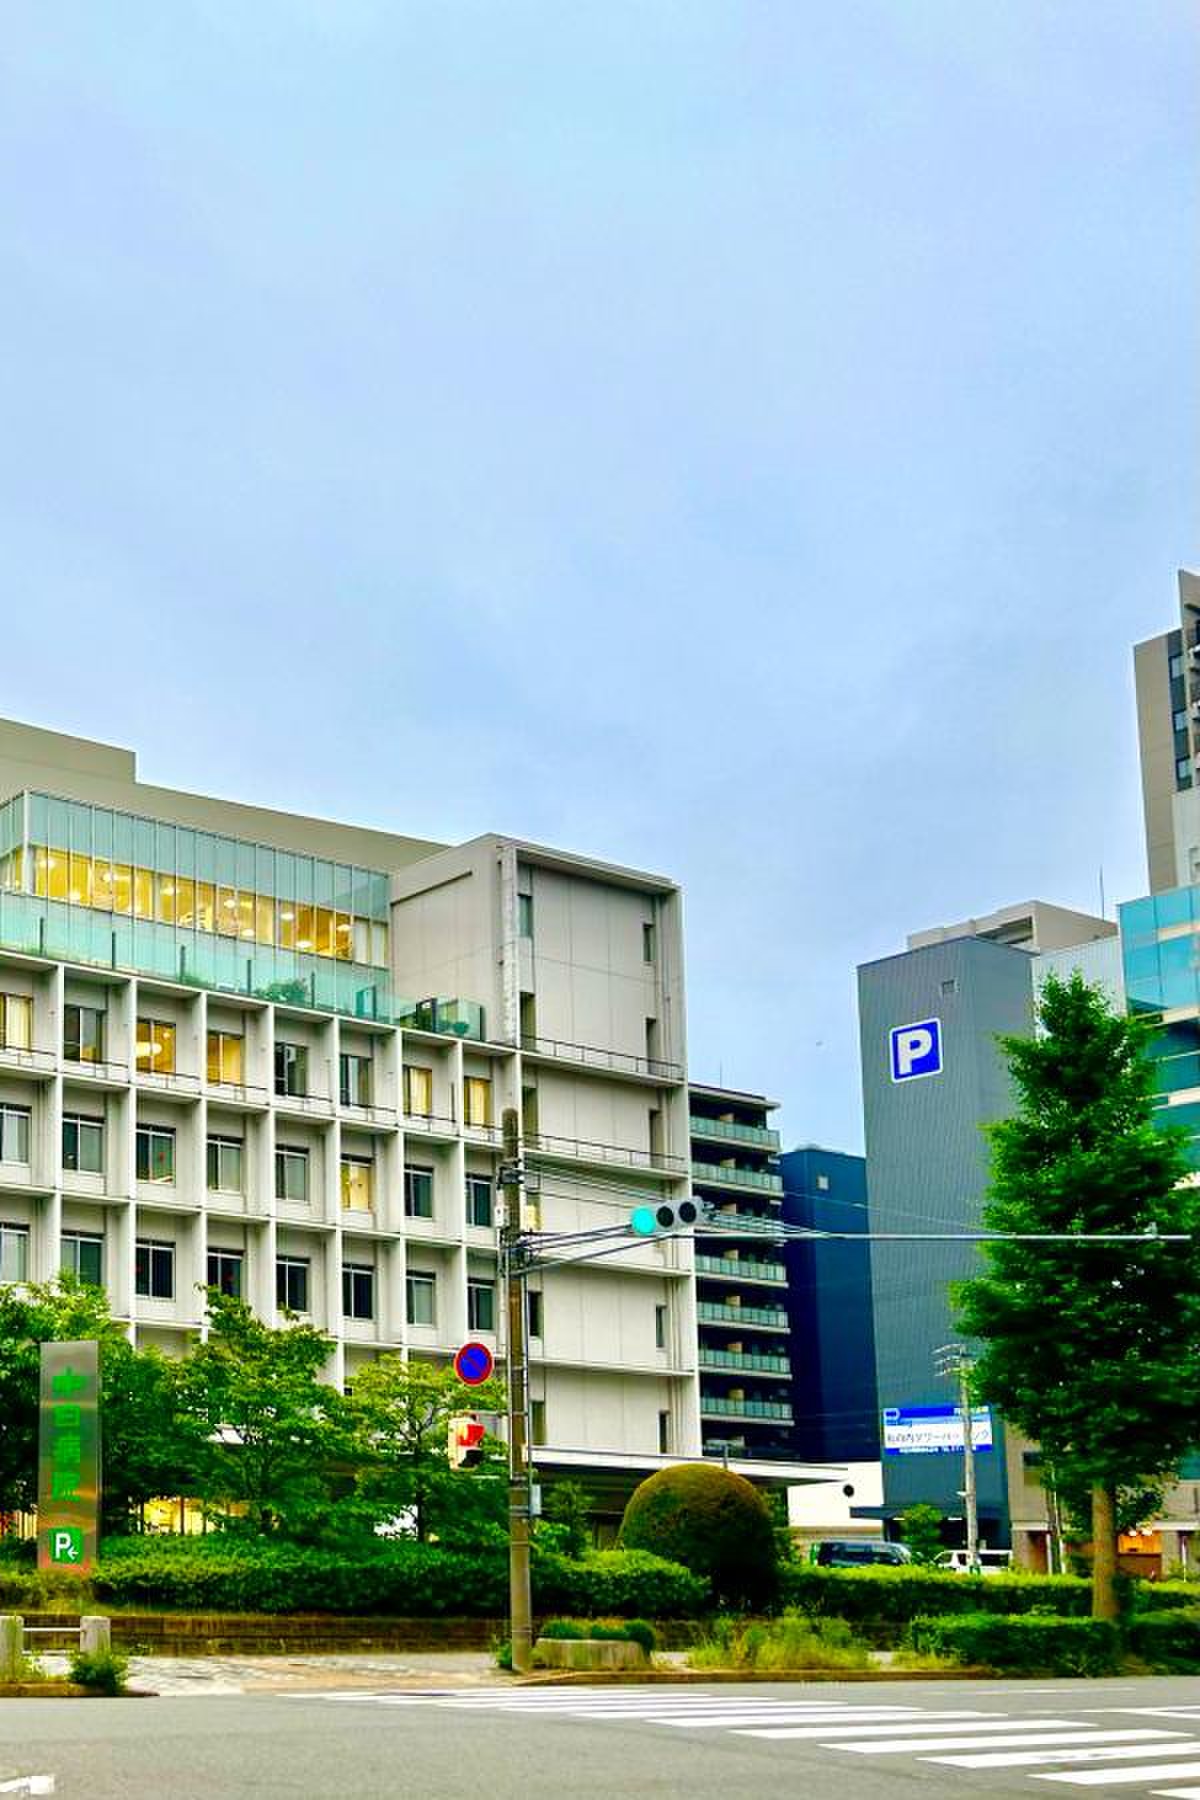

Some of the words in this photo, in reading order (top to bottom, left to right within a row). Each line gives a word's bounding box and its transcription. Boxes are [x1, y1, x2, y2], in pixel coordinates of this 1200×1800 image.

[896, 1028, 933, 1075] P
[887, 1428, 990, 1445] の内タワーパング
[55, 1532, 72, 1559] P
